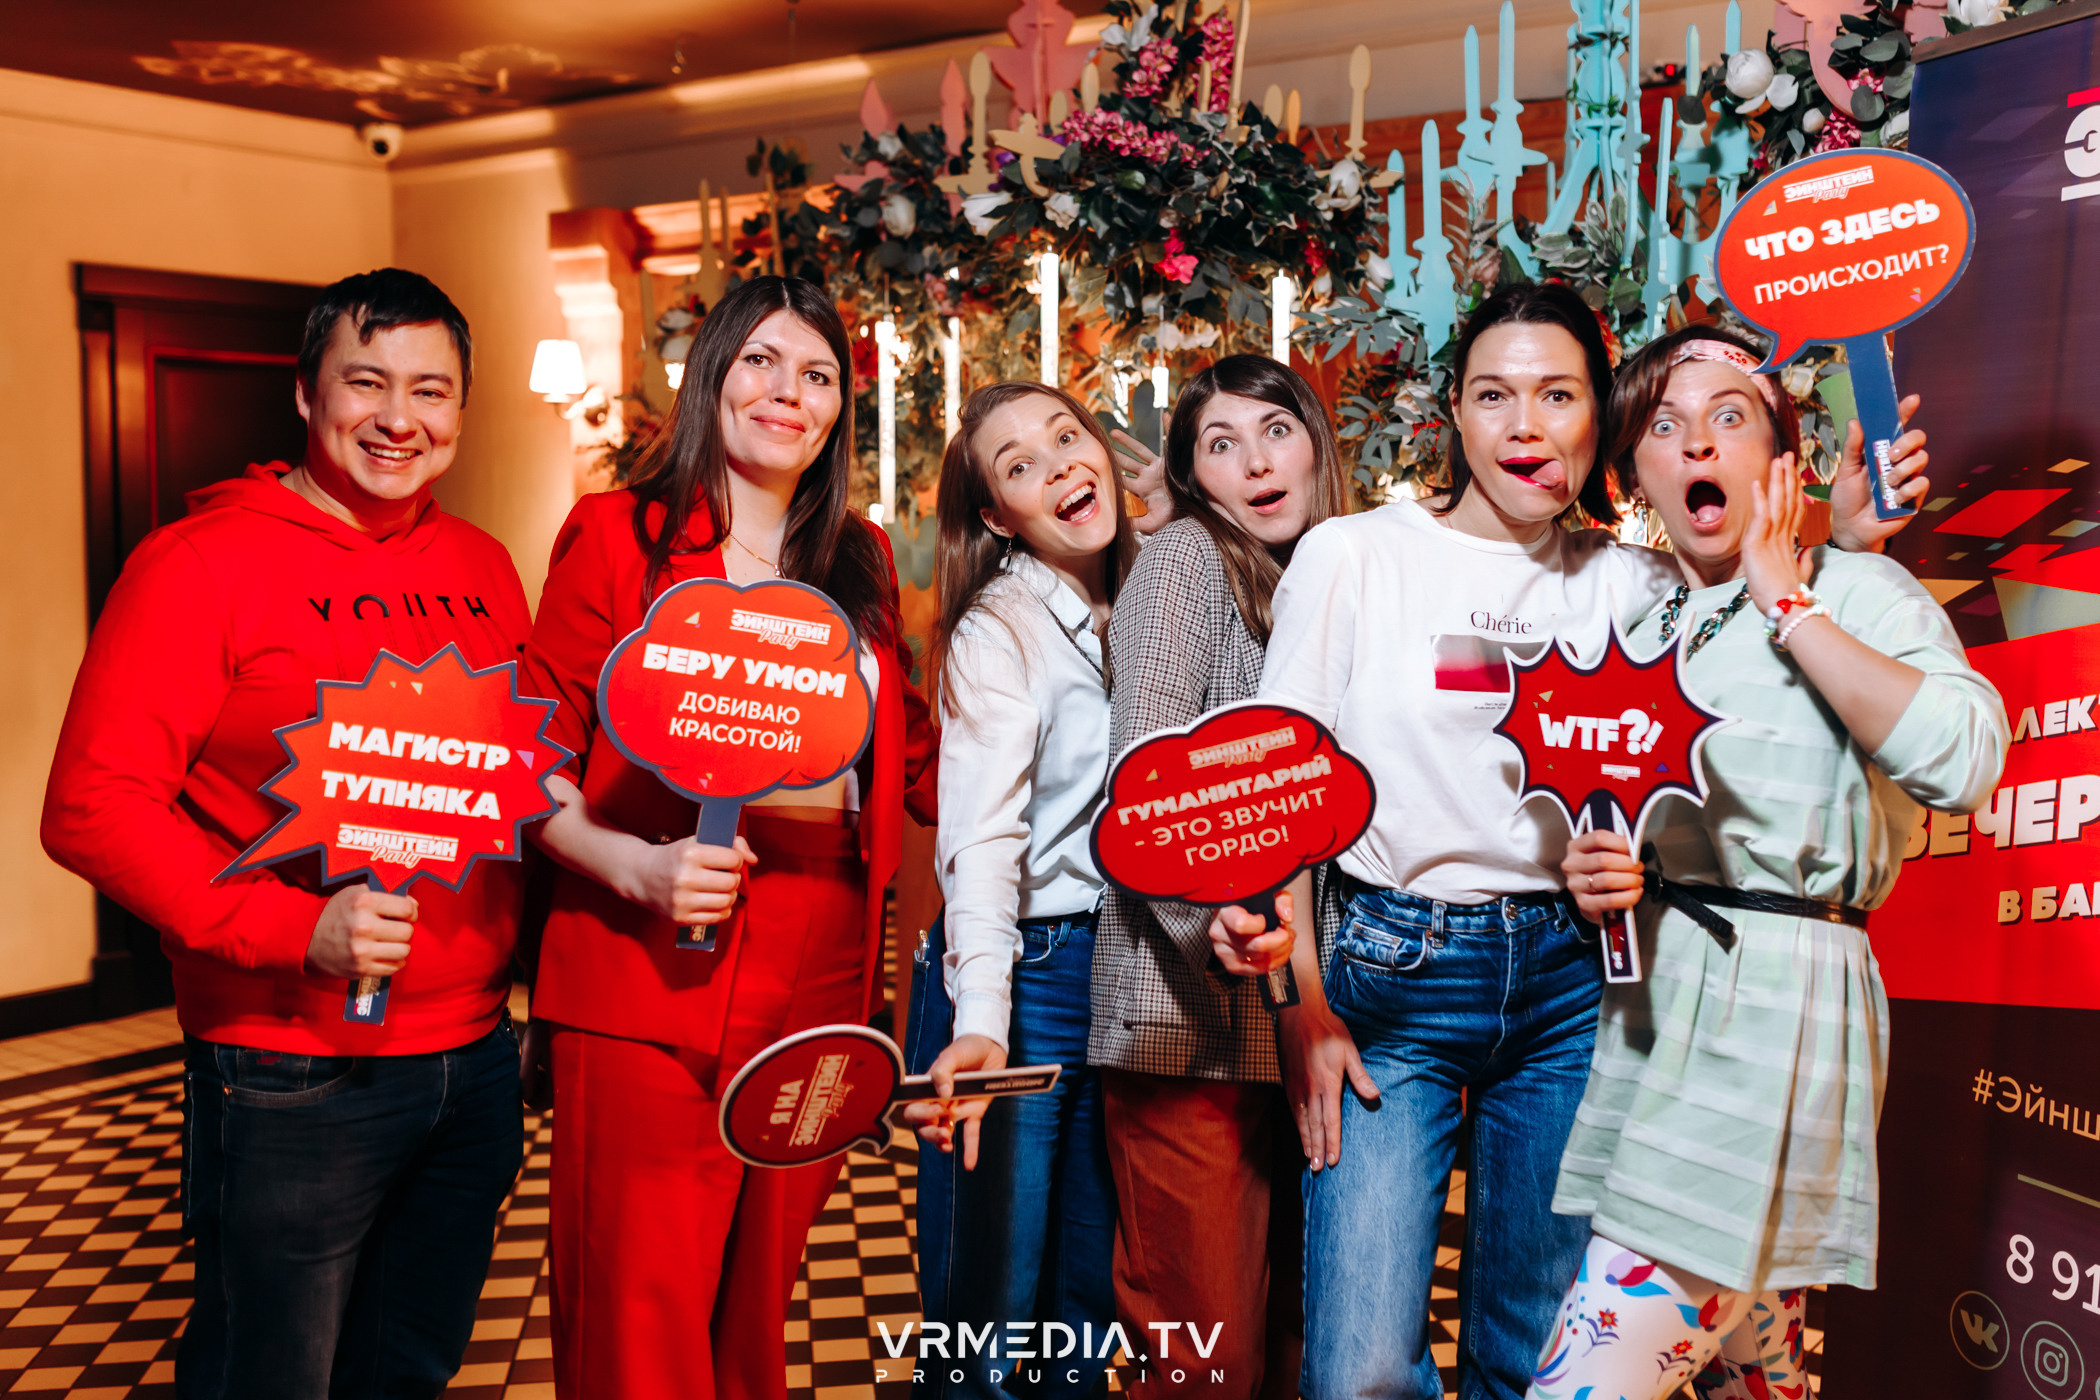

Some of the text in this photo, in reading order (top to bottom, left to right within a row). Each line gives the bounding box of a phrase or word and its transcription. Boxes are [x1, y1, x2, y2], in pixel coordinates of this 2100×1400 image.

[1812, 184, 1851, 203] Party
[1745, 198, 1941, 261] ЧТО ЗДЕСЬ
[1754, 243, 1950, 304] ПРОИСХОДИТ?
[757, 627, 803, 650] Party
[1470, 610, 1532, 635] Chérie
[642, 642, 847, 698] БЕРУ УМОМ
[677, 690, 801, 726] ДОБИВАЮ
[1537, 707, 1664, 755] WTF?!
[327, 721, 512, 771] МАГИСТР
[669, 716, 802, 754] КРАСОТОЙ!
[321, 769, 502, 821] ТУПНЯКА
[1117, 754, 1332, 826] ГУМАНИТАРИЙ
[1151, 816, 1213, 847] ЭТО
[1218, 786, 1328, 830] ЗВУЧИТ
[370, 844, 424, 869] Party
[1185, 825, 1290, 867] ГОРДО!
[1997, 881, 2100, 924] В БА
[2005, 1233, 2035, 1284] 8
